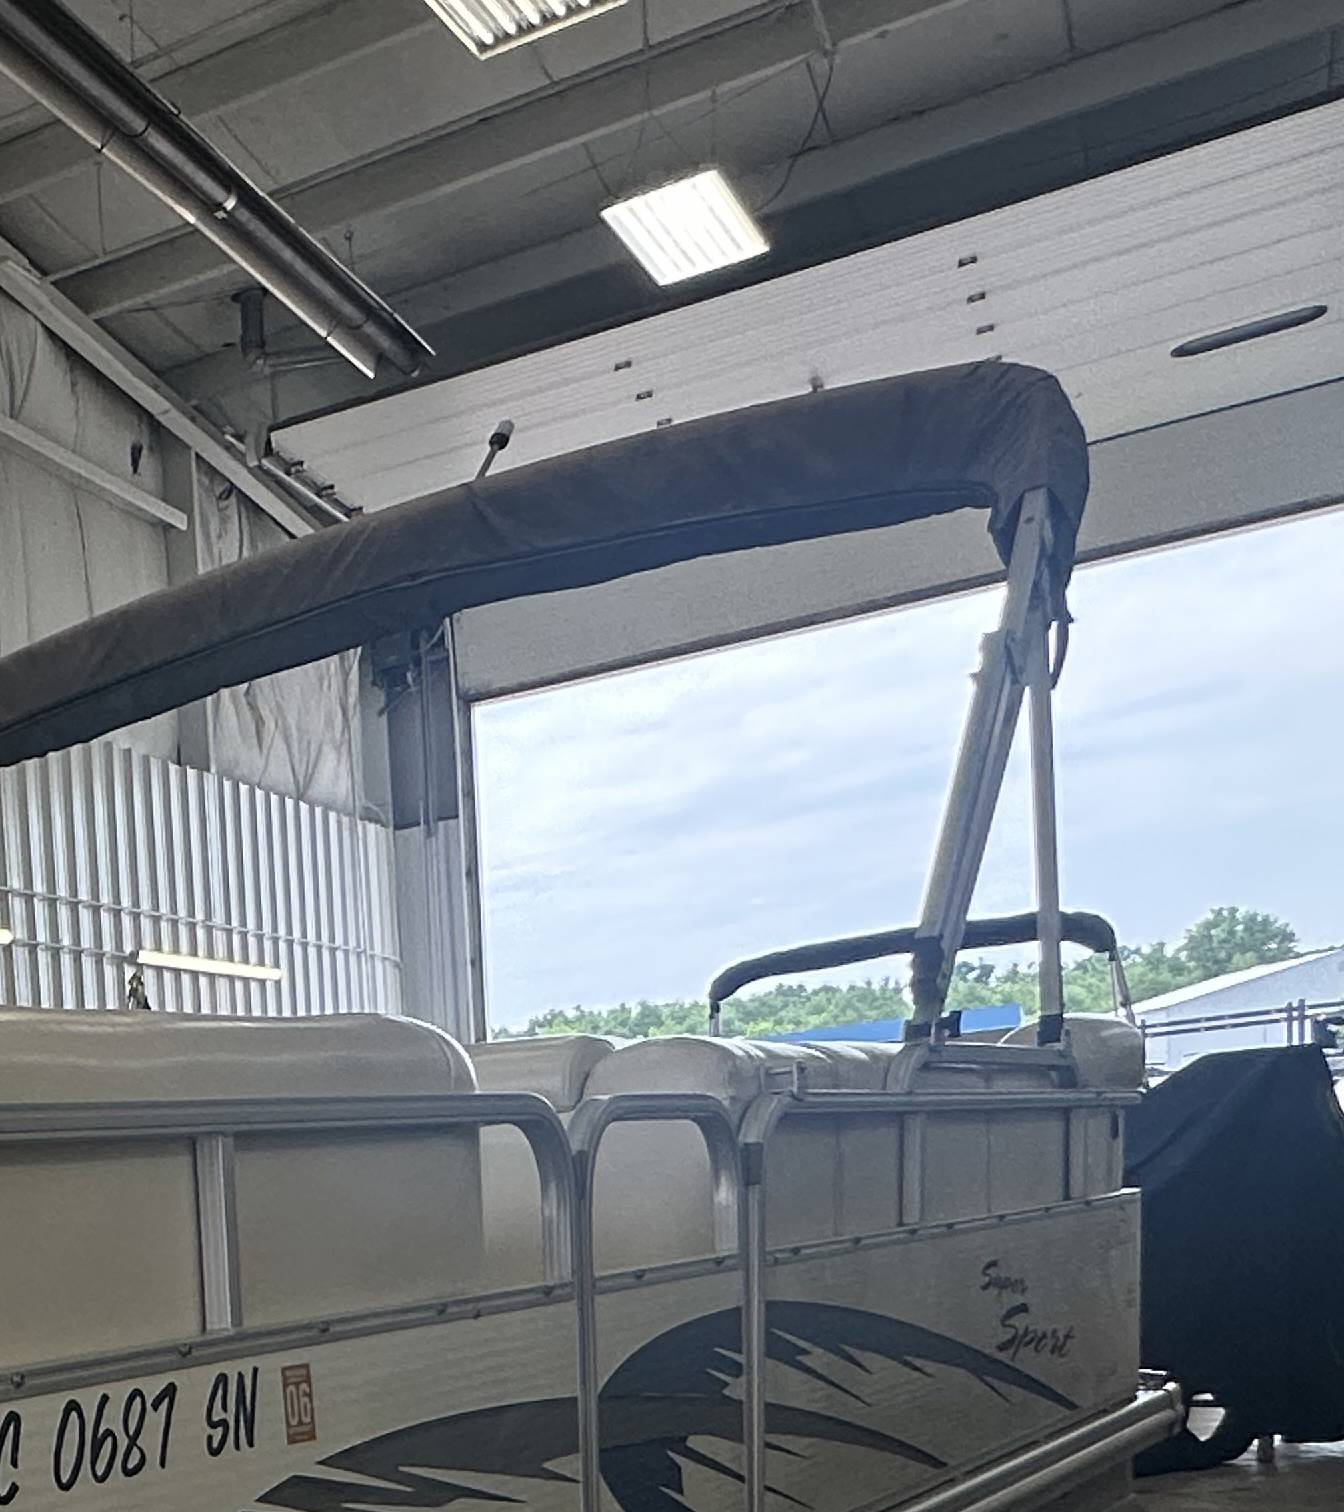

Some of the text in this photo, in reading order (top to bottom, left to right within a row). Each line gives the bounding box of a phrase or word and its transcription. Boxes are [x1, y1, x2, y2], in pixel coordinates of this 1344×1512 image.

[994, 1302, 1075, 1361] Sport
[53, 1381, 178, 1492] 0687
[205, 1366, 260, 1458] SN
